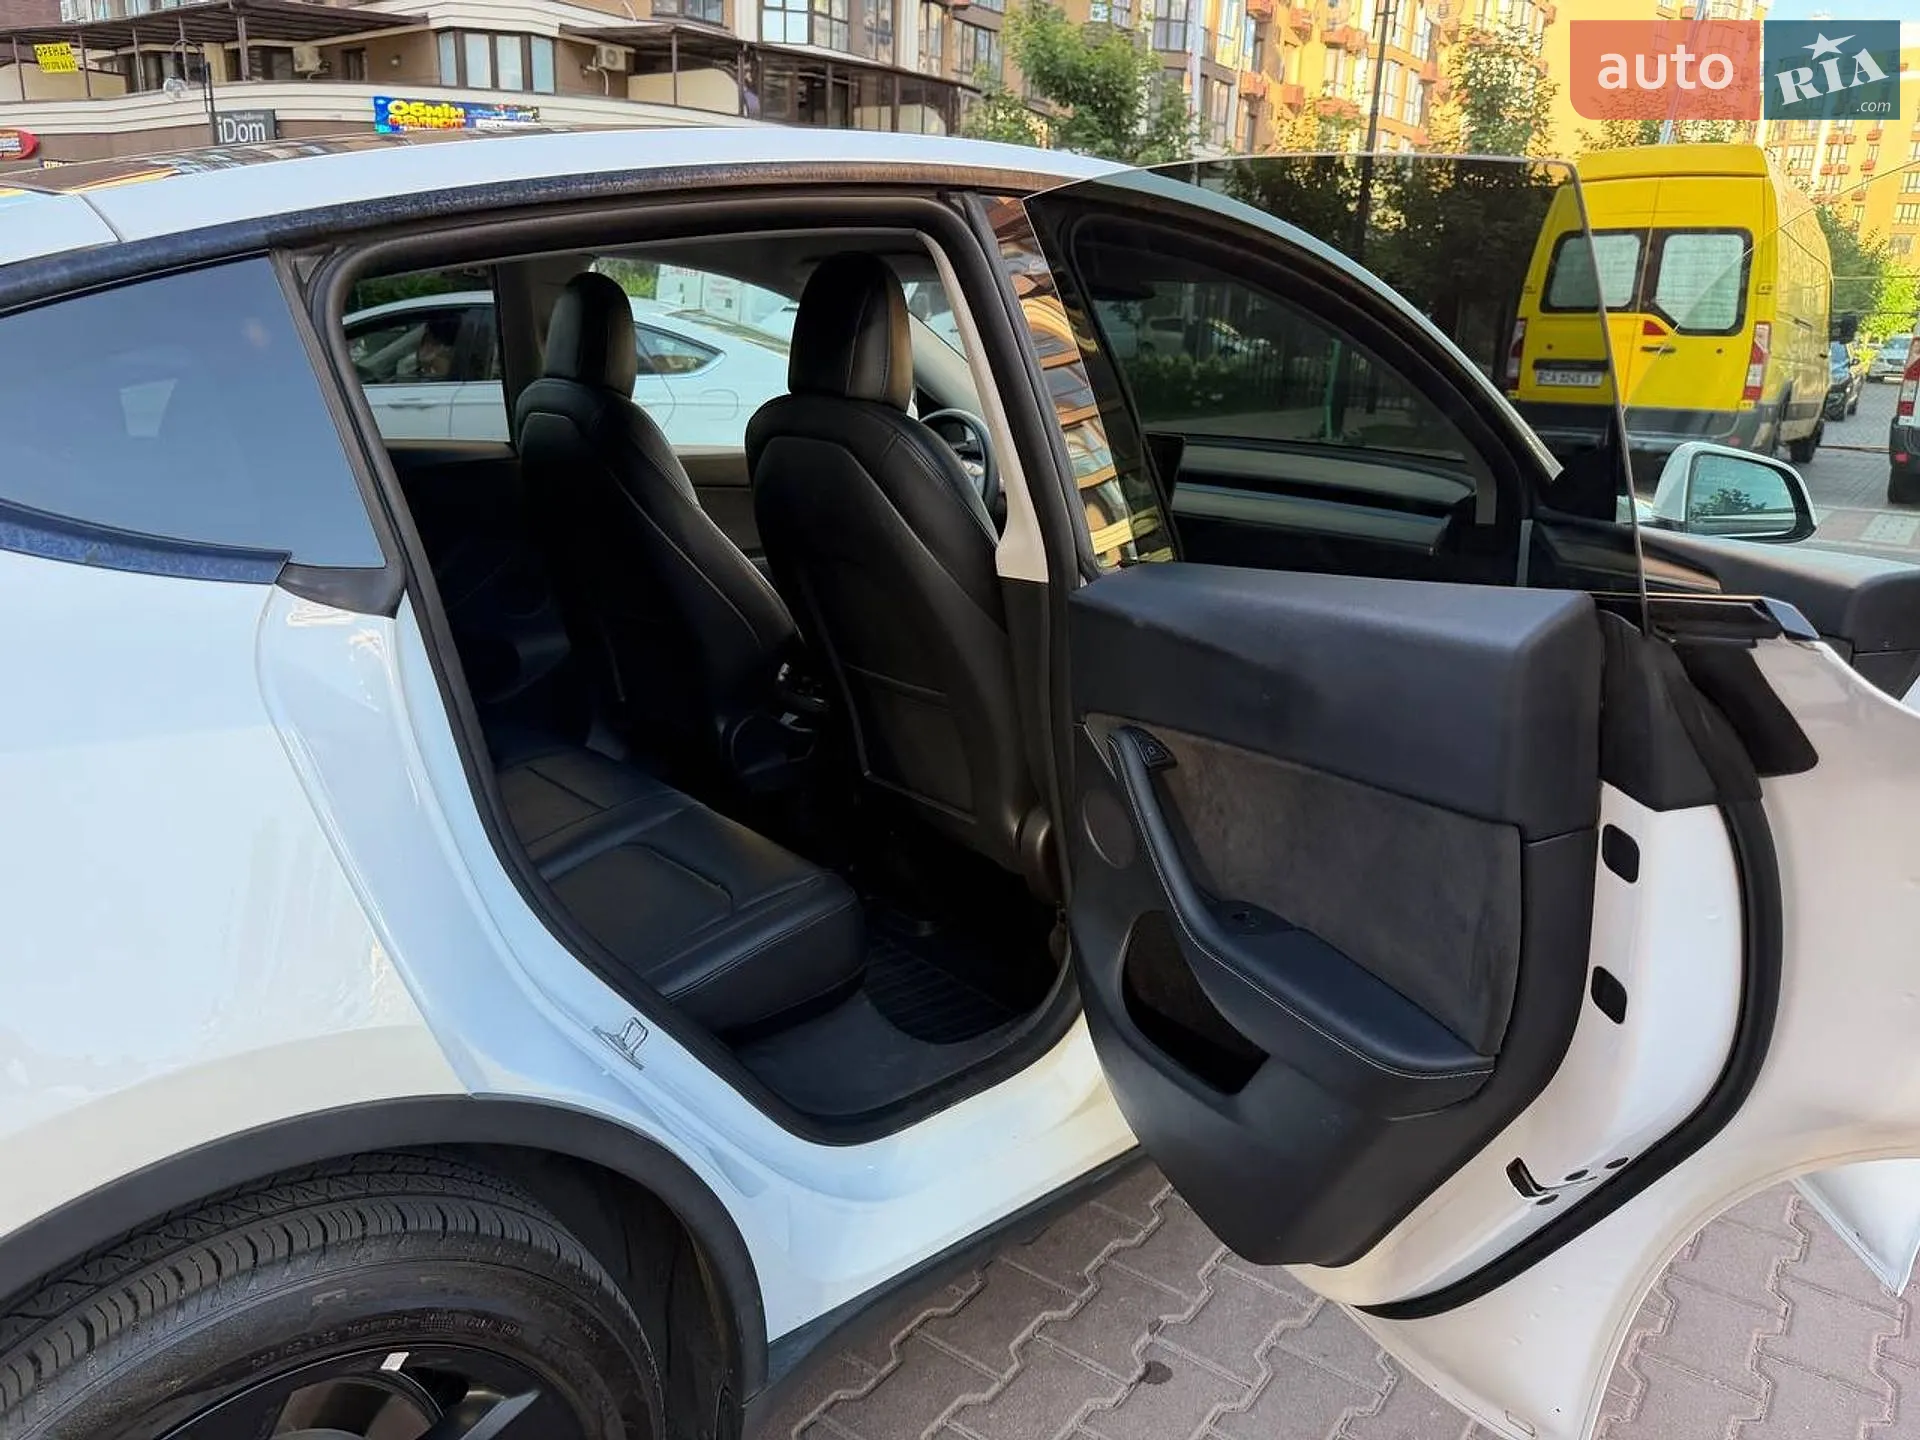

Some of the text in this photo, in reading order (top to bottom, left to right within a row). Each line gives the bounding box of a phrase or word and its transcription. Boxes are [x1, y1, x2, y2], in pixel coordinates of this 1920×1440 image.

[36, 45, 71, 57] ОРЕНДА
[388, 100, 465, 118] Обмін
[217, 116, 266, 143] iDom
